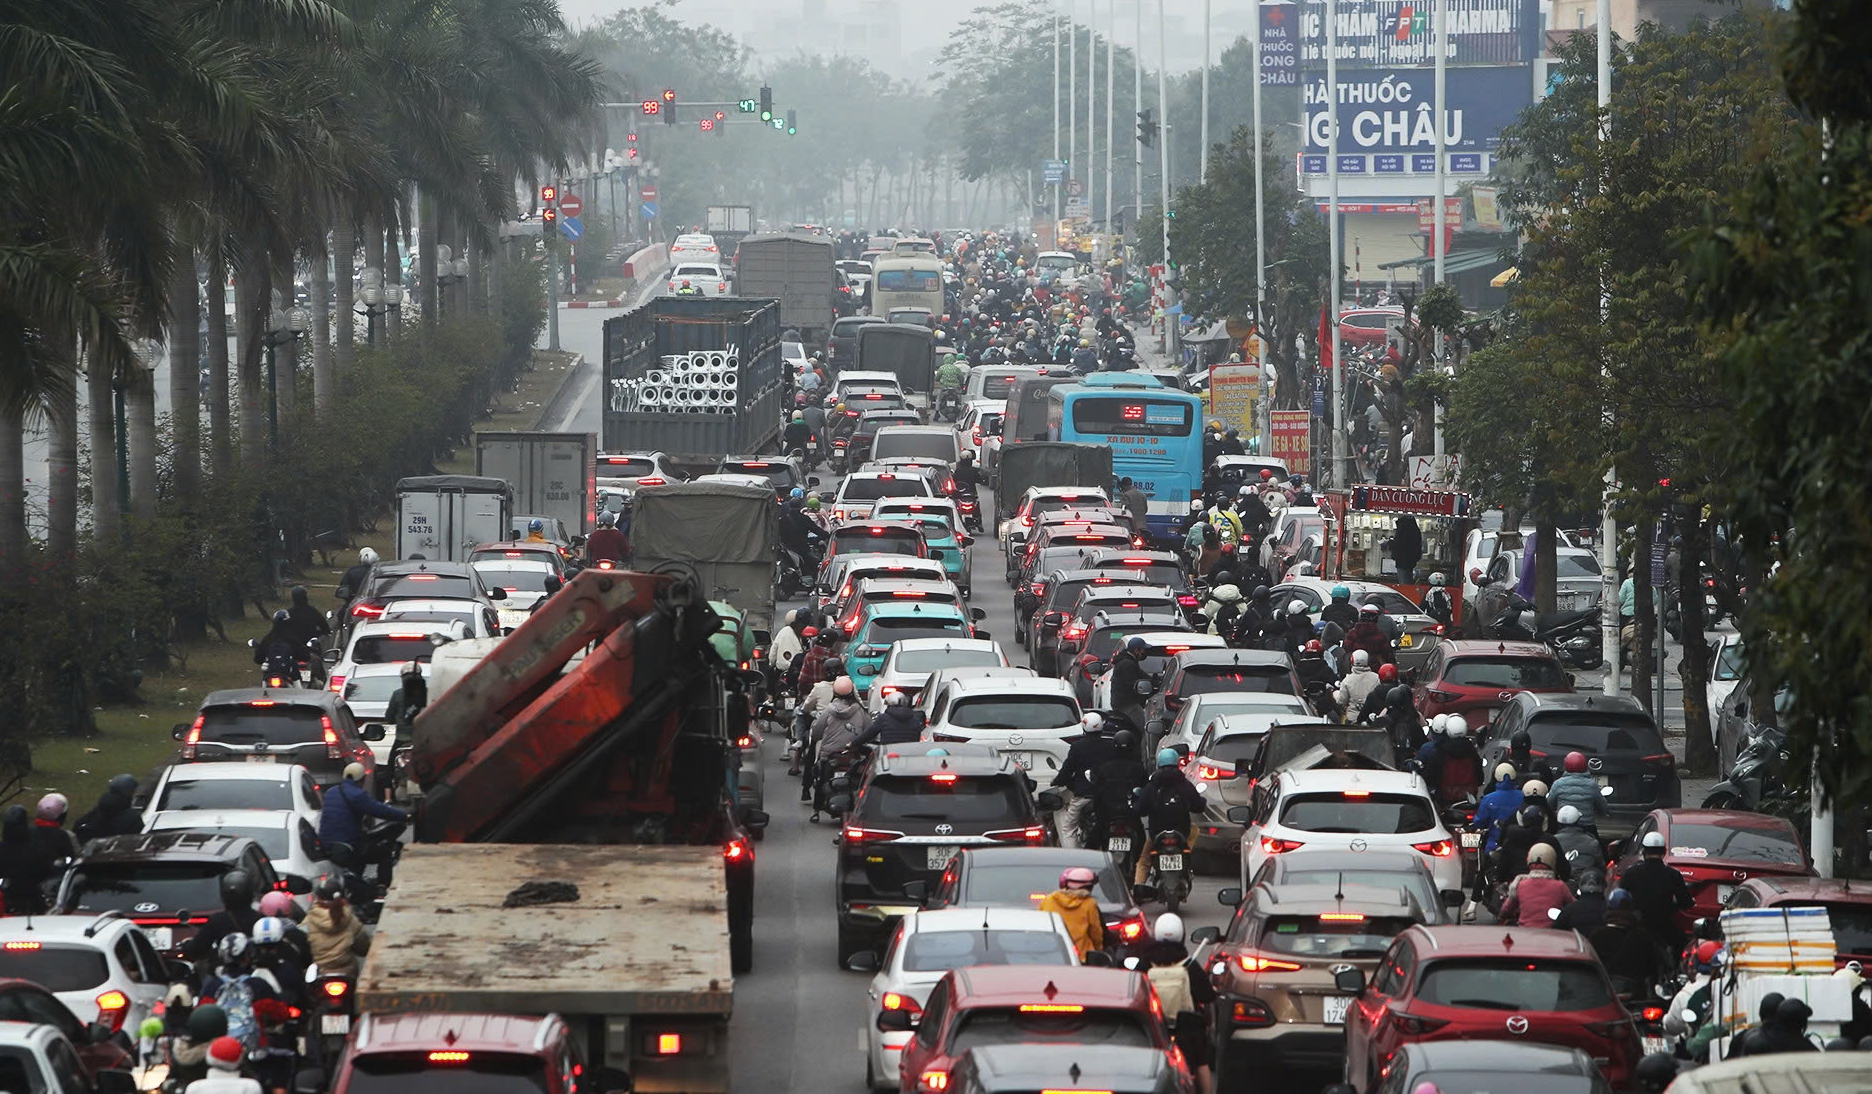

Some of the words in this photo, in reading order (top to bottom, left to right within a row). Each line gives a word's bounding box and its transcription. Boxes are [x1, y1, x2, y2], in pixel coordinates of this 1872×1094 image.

[1326, 5, 1377, 37] HẨM
[1385, 17, 1424, 30] FPT
[1433, 10, 1510, 36] HARMA
[1264, 27, 1287, 38] NHÀ
[1322, 41, 1356, 60] tuốc
[1260, 70, 1296, 85] CHÂU
[1303, 78, 1329, 104] HÀ
[1337, 74, 1413, 104] THUỐC
[1352, 101, 1463, 147] CHÂU
[1272, 435, 1280, 452] XE
[1280, 435, 1289, 452] GA
[1292, 435, 1300, 452] XE
[412, 516, 427, 524] 29H
[407, 525, 433, 534] 543.76
